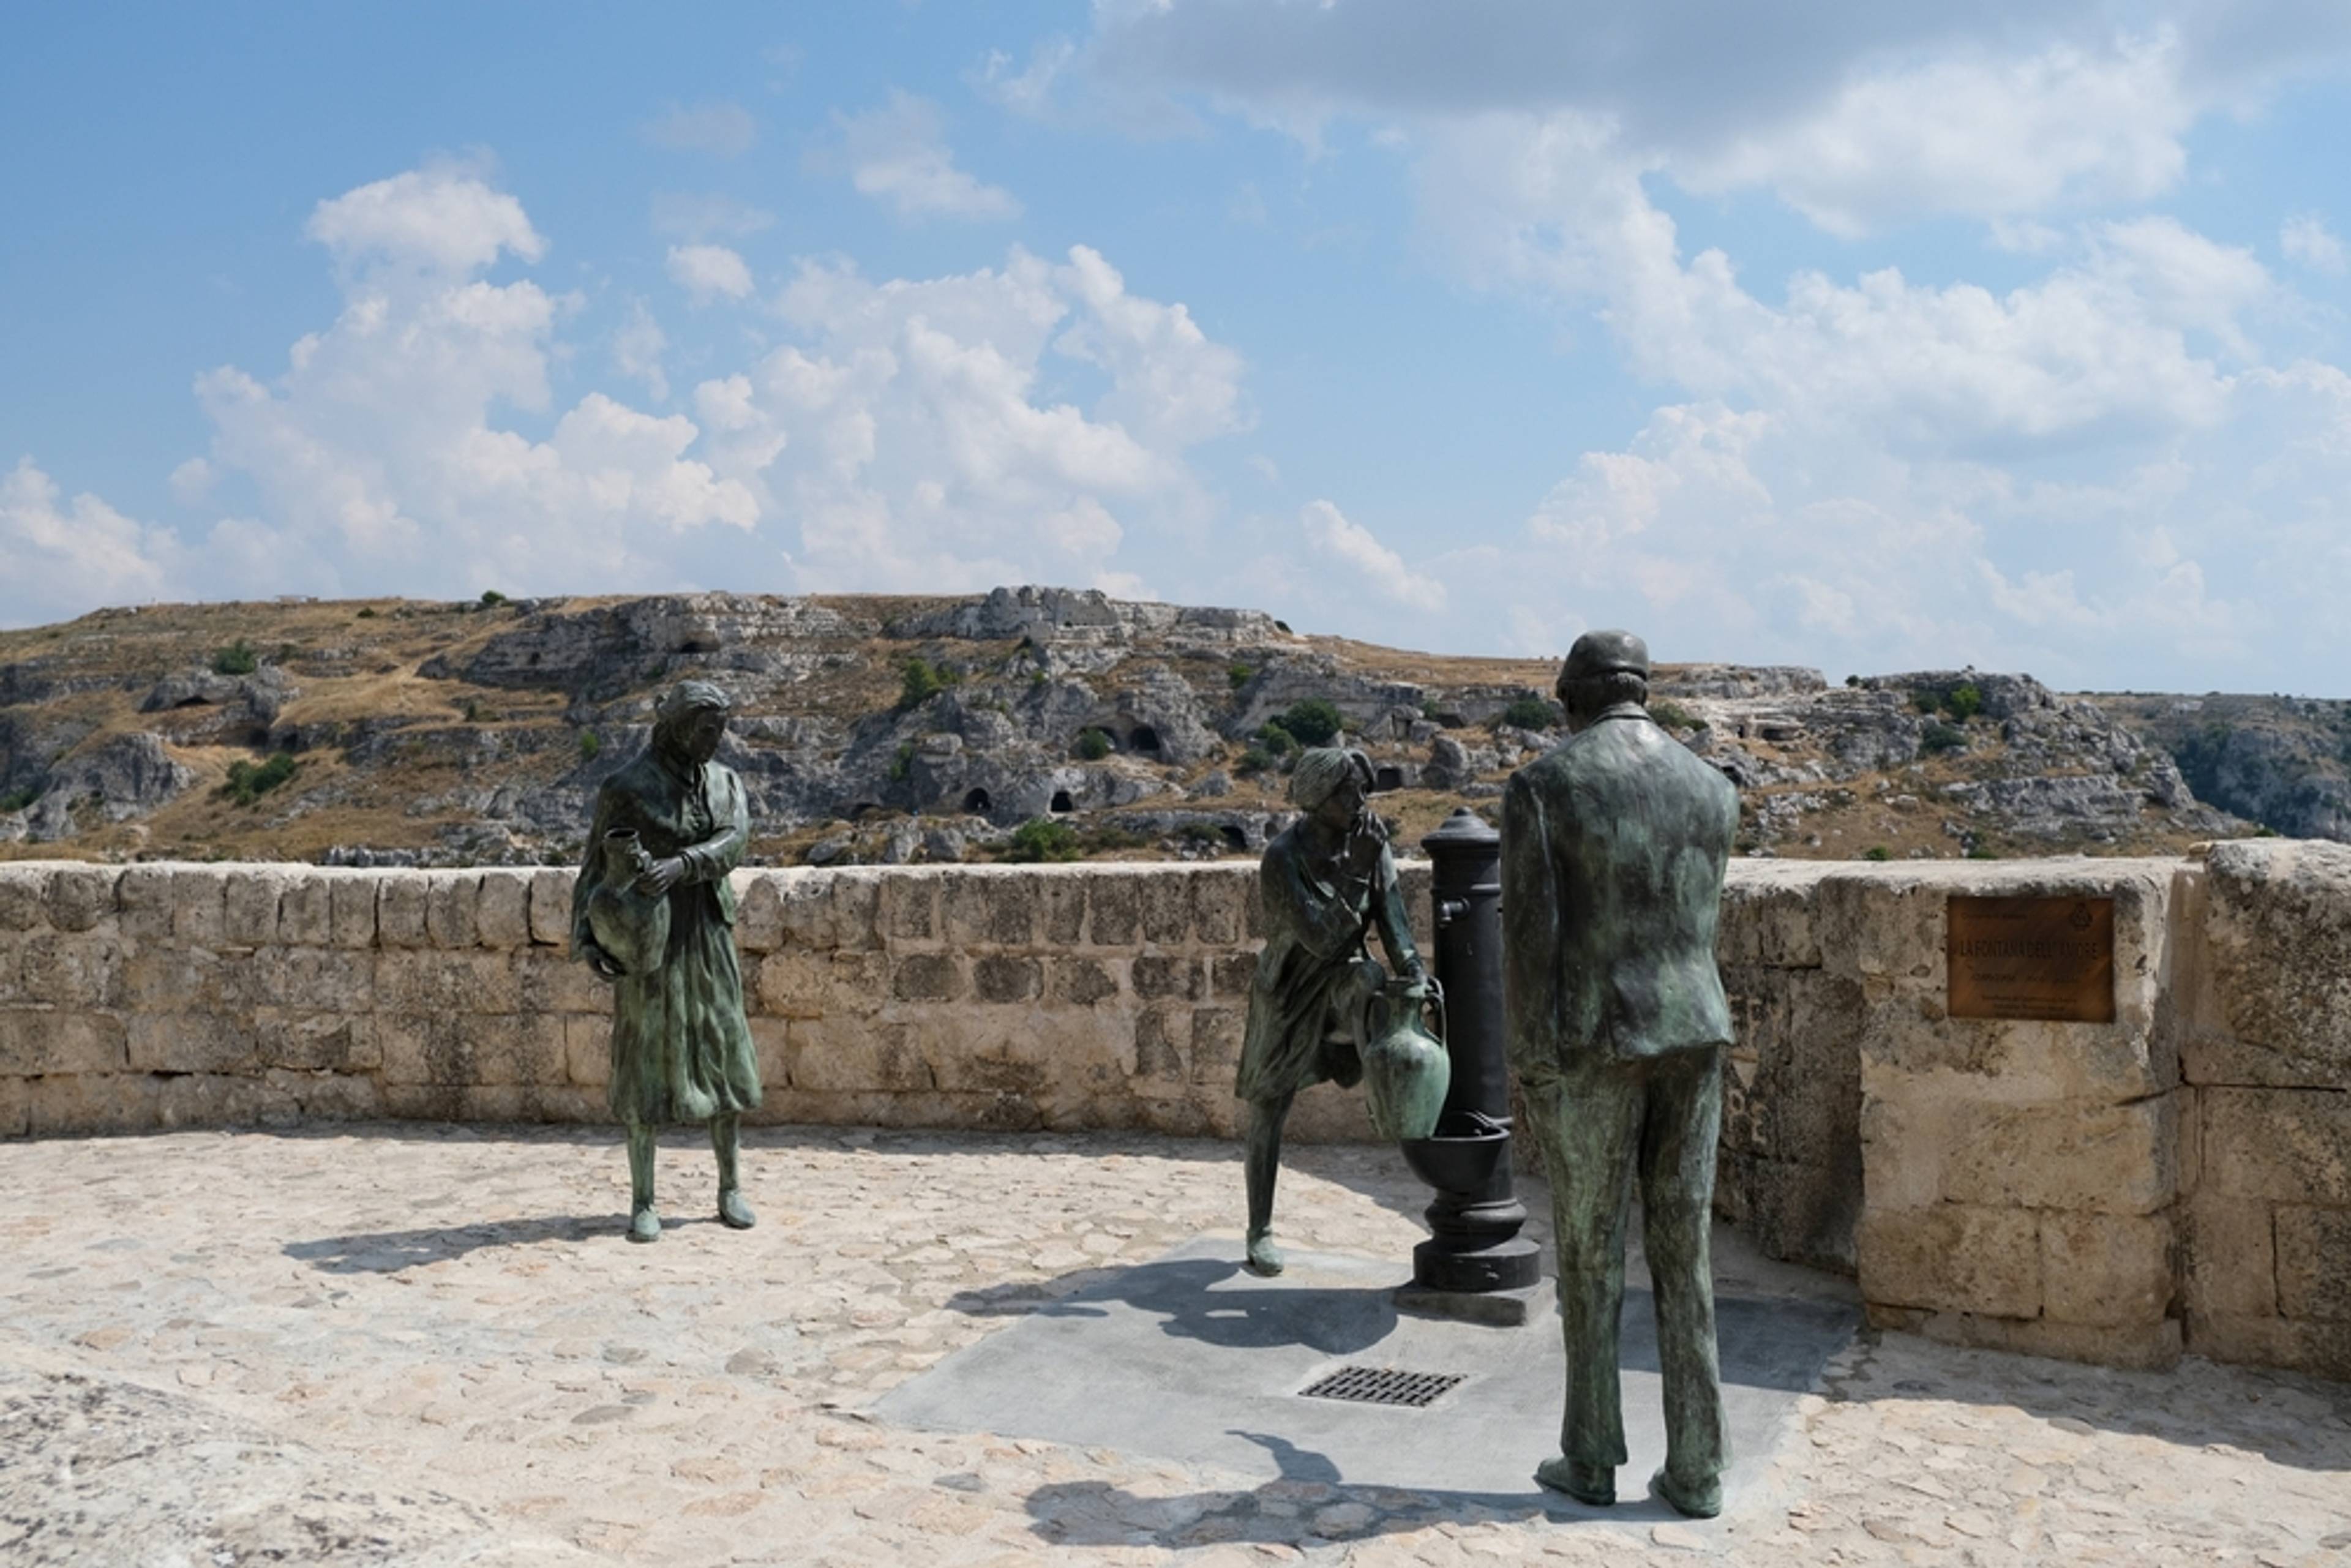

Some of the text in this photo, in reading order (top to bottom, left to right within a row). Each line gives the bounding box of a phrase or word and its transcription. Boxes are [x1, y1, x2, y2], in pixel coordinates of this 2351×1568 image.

[1960, 940, 1973, 958] LA
[1976, 940, 2024, 959] FONTANA
[2060, 941, 2098, 960] AMORE
